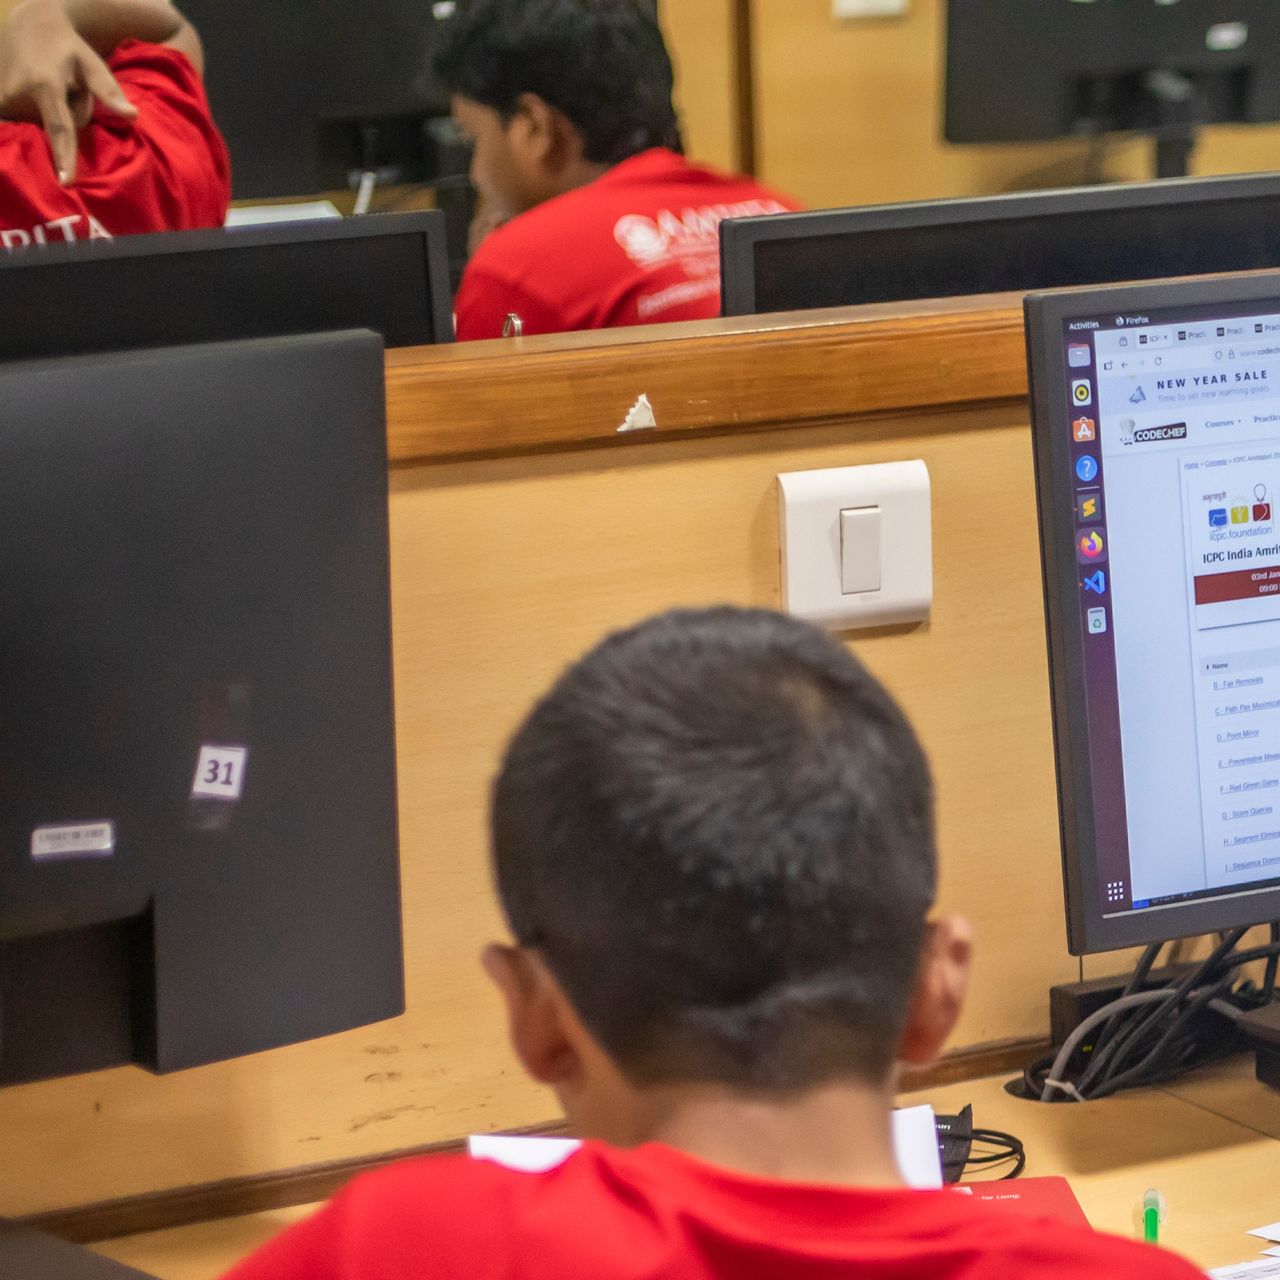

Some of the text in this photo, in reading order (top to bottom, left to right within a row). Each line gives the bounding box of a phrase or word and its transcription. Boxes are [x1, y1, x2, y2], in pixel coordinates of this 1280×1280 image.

[1069, 316, 1149, 331] Activities Firefox
[1157, 370, 1269, 390] NEW YEAR SALE
[1205, 419, 1234, 428] Courses
[1136, 426, 1186, 442] CODECHEF
[1210, 526, 1272, 542] icpc.foundation
[1203, 552, 1225, 564] ICPC
[1227, 548, 1252, 561] India
[1252, 572, 1266, 581] 03rd
[1268, 571, 1280, 579] Jan
[1212, 662, 1228, 670] Name
[204, 759, 234, 786] 31
